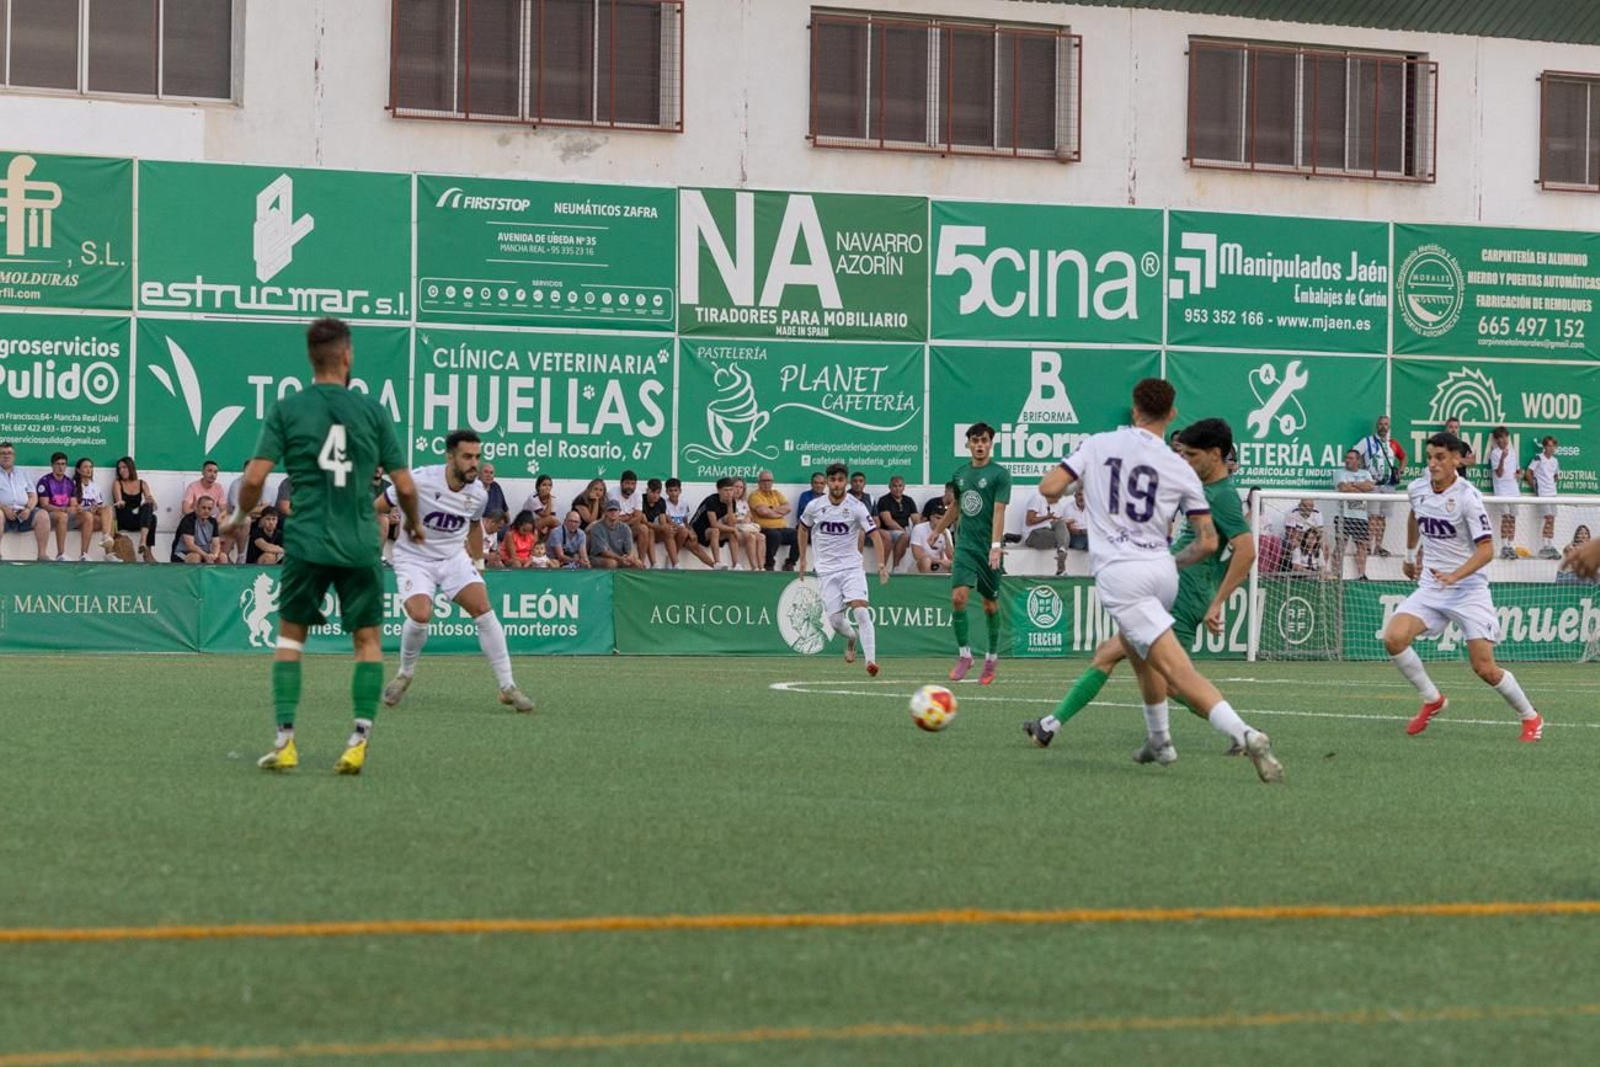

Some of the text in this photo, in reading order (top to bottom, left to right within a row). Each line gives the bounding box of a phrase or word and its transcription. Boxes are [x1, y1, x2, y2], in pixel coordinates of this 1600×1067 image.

[463, 195, 531, 212] FIRSTSTOP
[554, 199, 659, 219] NEUMÁTICOS ZAFRA
[497, 232, 534, 243] AVENIDA
[534, 234, 546, 244] DE
[546, 231, 574, 245] ÚBEDA
[586, 236, 597, 246] 35
[500, 243, 528, 253] MANCHA
[528, 244, 546, 254] REAL
[679, 189, 844, 309] NA
[836, 231, 923, 254] NAVARRO
[836, 253, 904, 275] AZORÍN
[1219, 242, 1387, 283] Manipulados Jaén
[1481, 248, 1588, 267] CARPINTERÍA EN ALUMINIO
[532, 279, 563, 288] SERVICIOS
[1467, 271, 1499, 286] HIERRO
[1499, 272, 1506, 286] Y
[1506, 273, 1543, 288] PUERTAS
[1294, 283, 1387, 308] Embalajes de Cartón
[1476, 293, 1592, 313] FABRICACIÓN DE REMOLQUES
[695, 307, 908, 328] TIRADORES PARA MOBILIARIO
[1184, 308, 1209, 324] 953
[1213, 309, 1236, 325] 352
[1241, 311, 1264, 326] 166
[1276, 314, 1371, 332] www.mjaen.es
[1477, 315, 1585, 338] 665 497 152
[776, 325, 829, 337] MADE IN SPAIN
[433, 342, 657, 374] CLÍNICA VETERINARIA
[697, 345, 768, 361] PASTELERÍA
[780, 363, 889, 393] PLANET
[423, 372, 666, 438] HUELLAS
[821, 391, 916, 412] CAFETERÍA
[1521, 392, 1582, 419] WOOD
[54, 412, 81, 422] Mancha
[81, 413, 98, 422] Real
[1022, 410, 1074, 422] BRIFORMA
[318, 424, 353, 487] 4
[524, 439, 552, 458] del
[558, 440, 626, 462] Rosario,
[632, 441, 653, 460] 67
[1246, 465, 1296, 477] AGRÍCOLAS
[1298, 468, 1304, 476] E
[1104, 457, 1159, 523] 19
[14, 594, 103, 614] MANCHA
[107, 594, 158, 615] REAL
[502, 588, 580, 619] LEÓN
[650, 603, 771, 625] AGRÍCOLA
